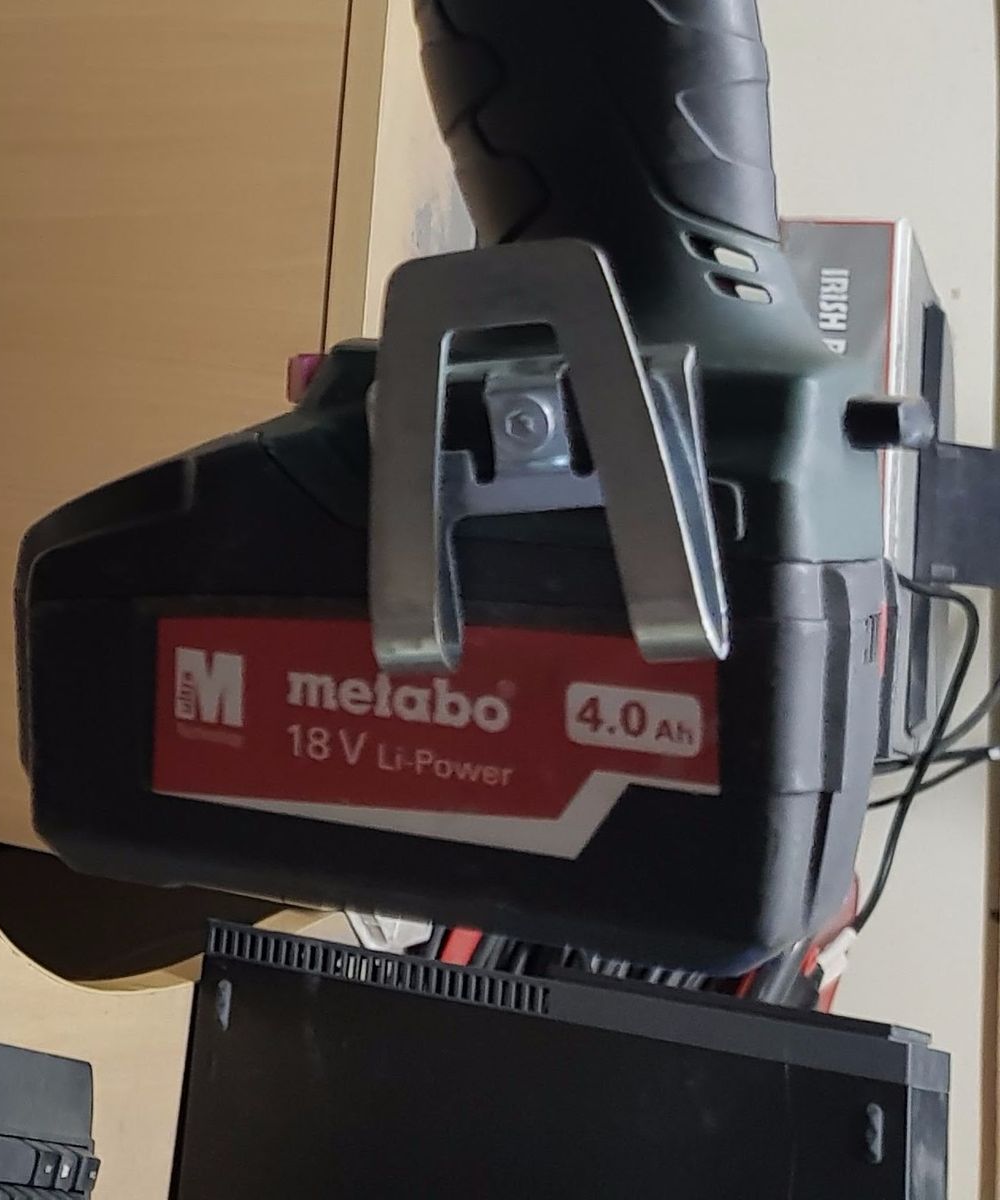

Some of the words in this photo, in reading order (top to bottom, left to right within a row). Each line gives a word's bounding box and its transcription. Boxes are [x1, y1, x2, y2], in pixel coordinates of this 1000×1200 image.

[819, 269, 849, 331] IRISH
[286, 671, 510, 734] metabo
[575, 696, 648, 738] 4.0
[654, 719, 694, 746] Ah
[286, 723, 332, 761] 18
[338, 728, 370, 766] V
[377, 743, 515, 786] Li-Power
